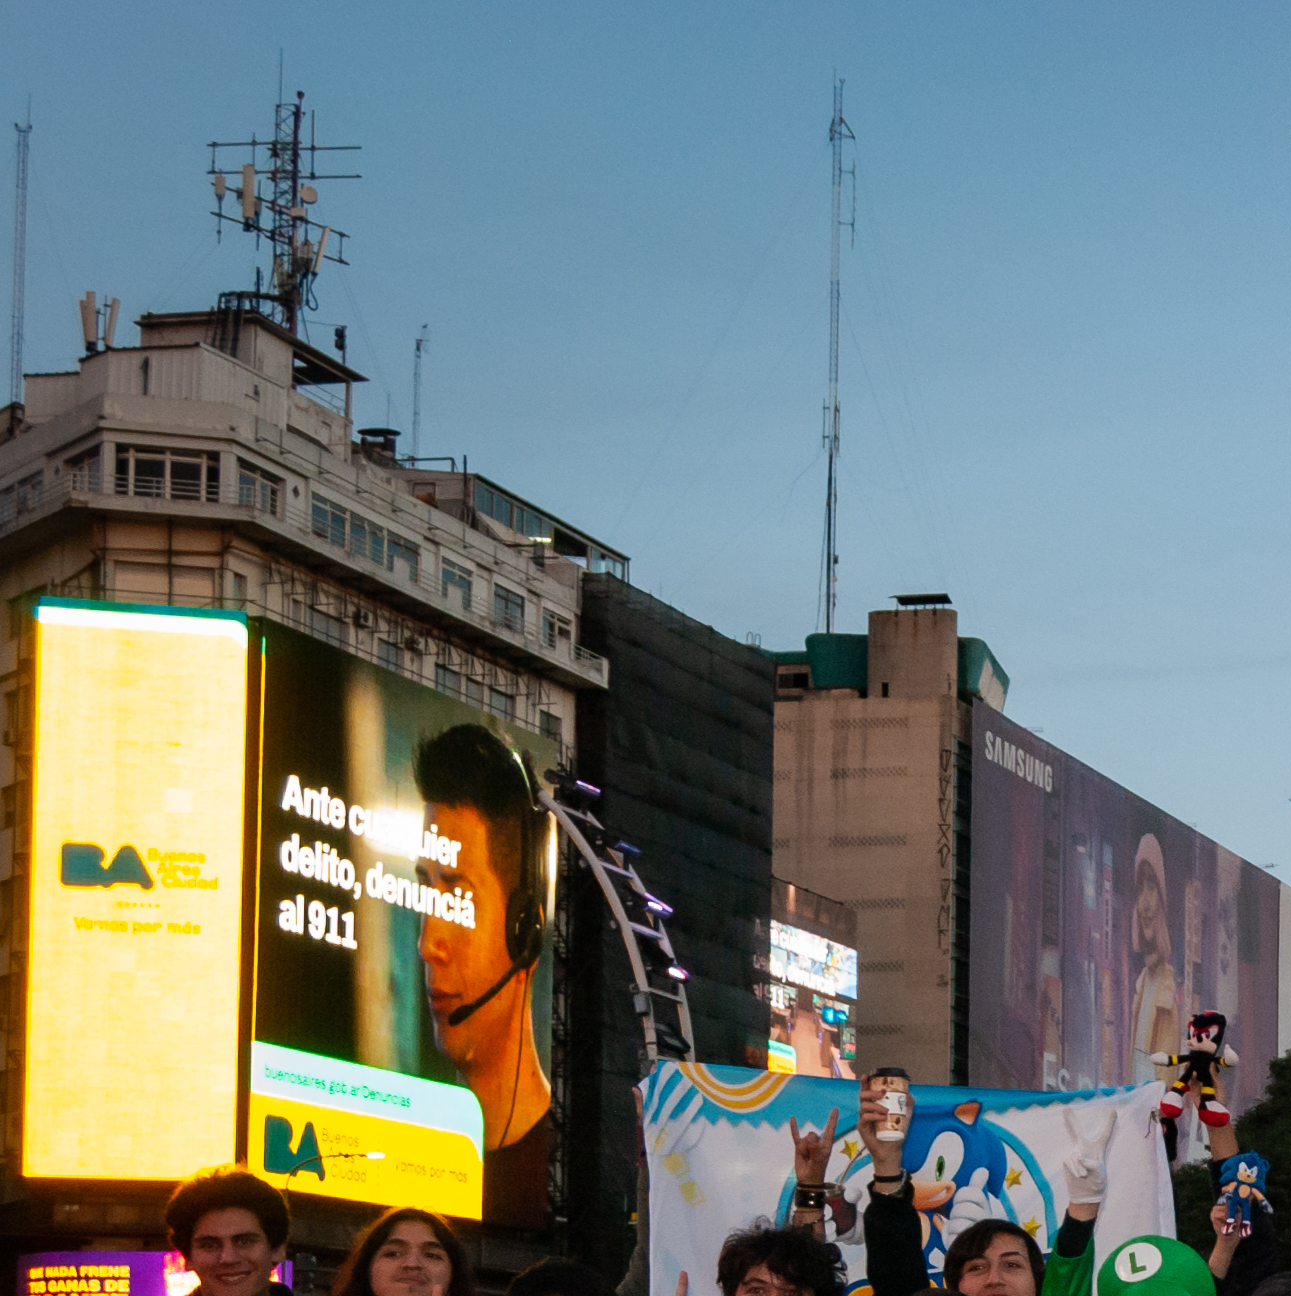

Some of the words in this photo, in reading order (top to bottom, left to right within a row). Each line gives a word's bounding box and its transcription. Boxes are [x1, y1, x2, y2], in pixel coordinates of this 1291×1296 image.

[985, 730, 1053, 793] SAMSUNG
[281, 774, 346, 829] Ante
[349, 804, 461, 869] cuquier
[281, 833, 362, 900] delito,
[365, 861, 476, 930] denunciá
[279, 894, 304, 934] al
[308, 899, 358, 950] 911
[45, 1265, 78, 1278] NADA
[79, 1265, 131, 1278] FRENE
[47, 1279, 101, 1293] GANAS
[104, 1279, 130, 1293] DE
[1129, 1251, 1147, 1274] L
